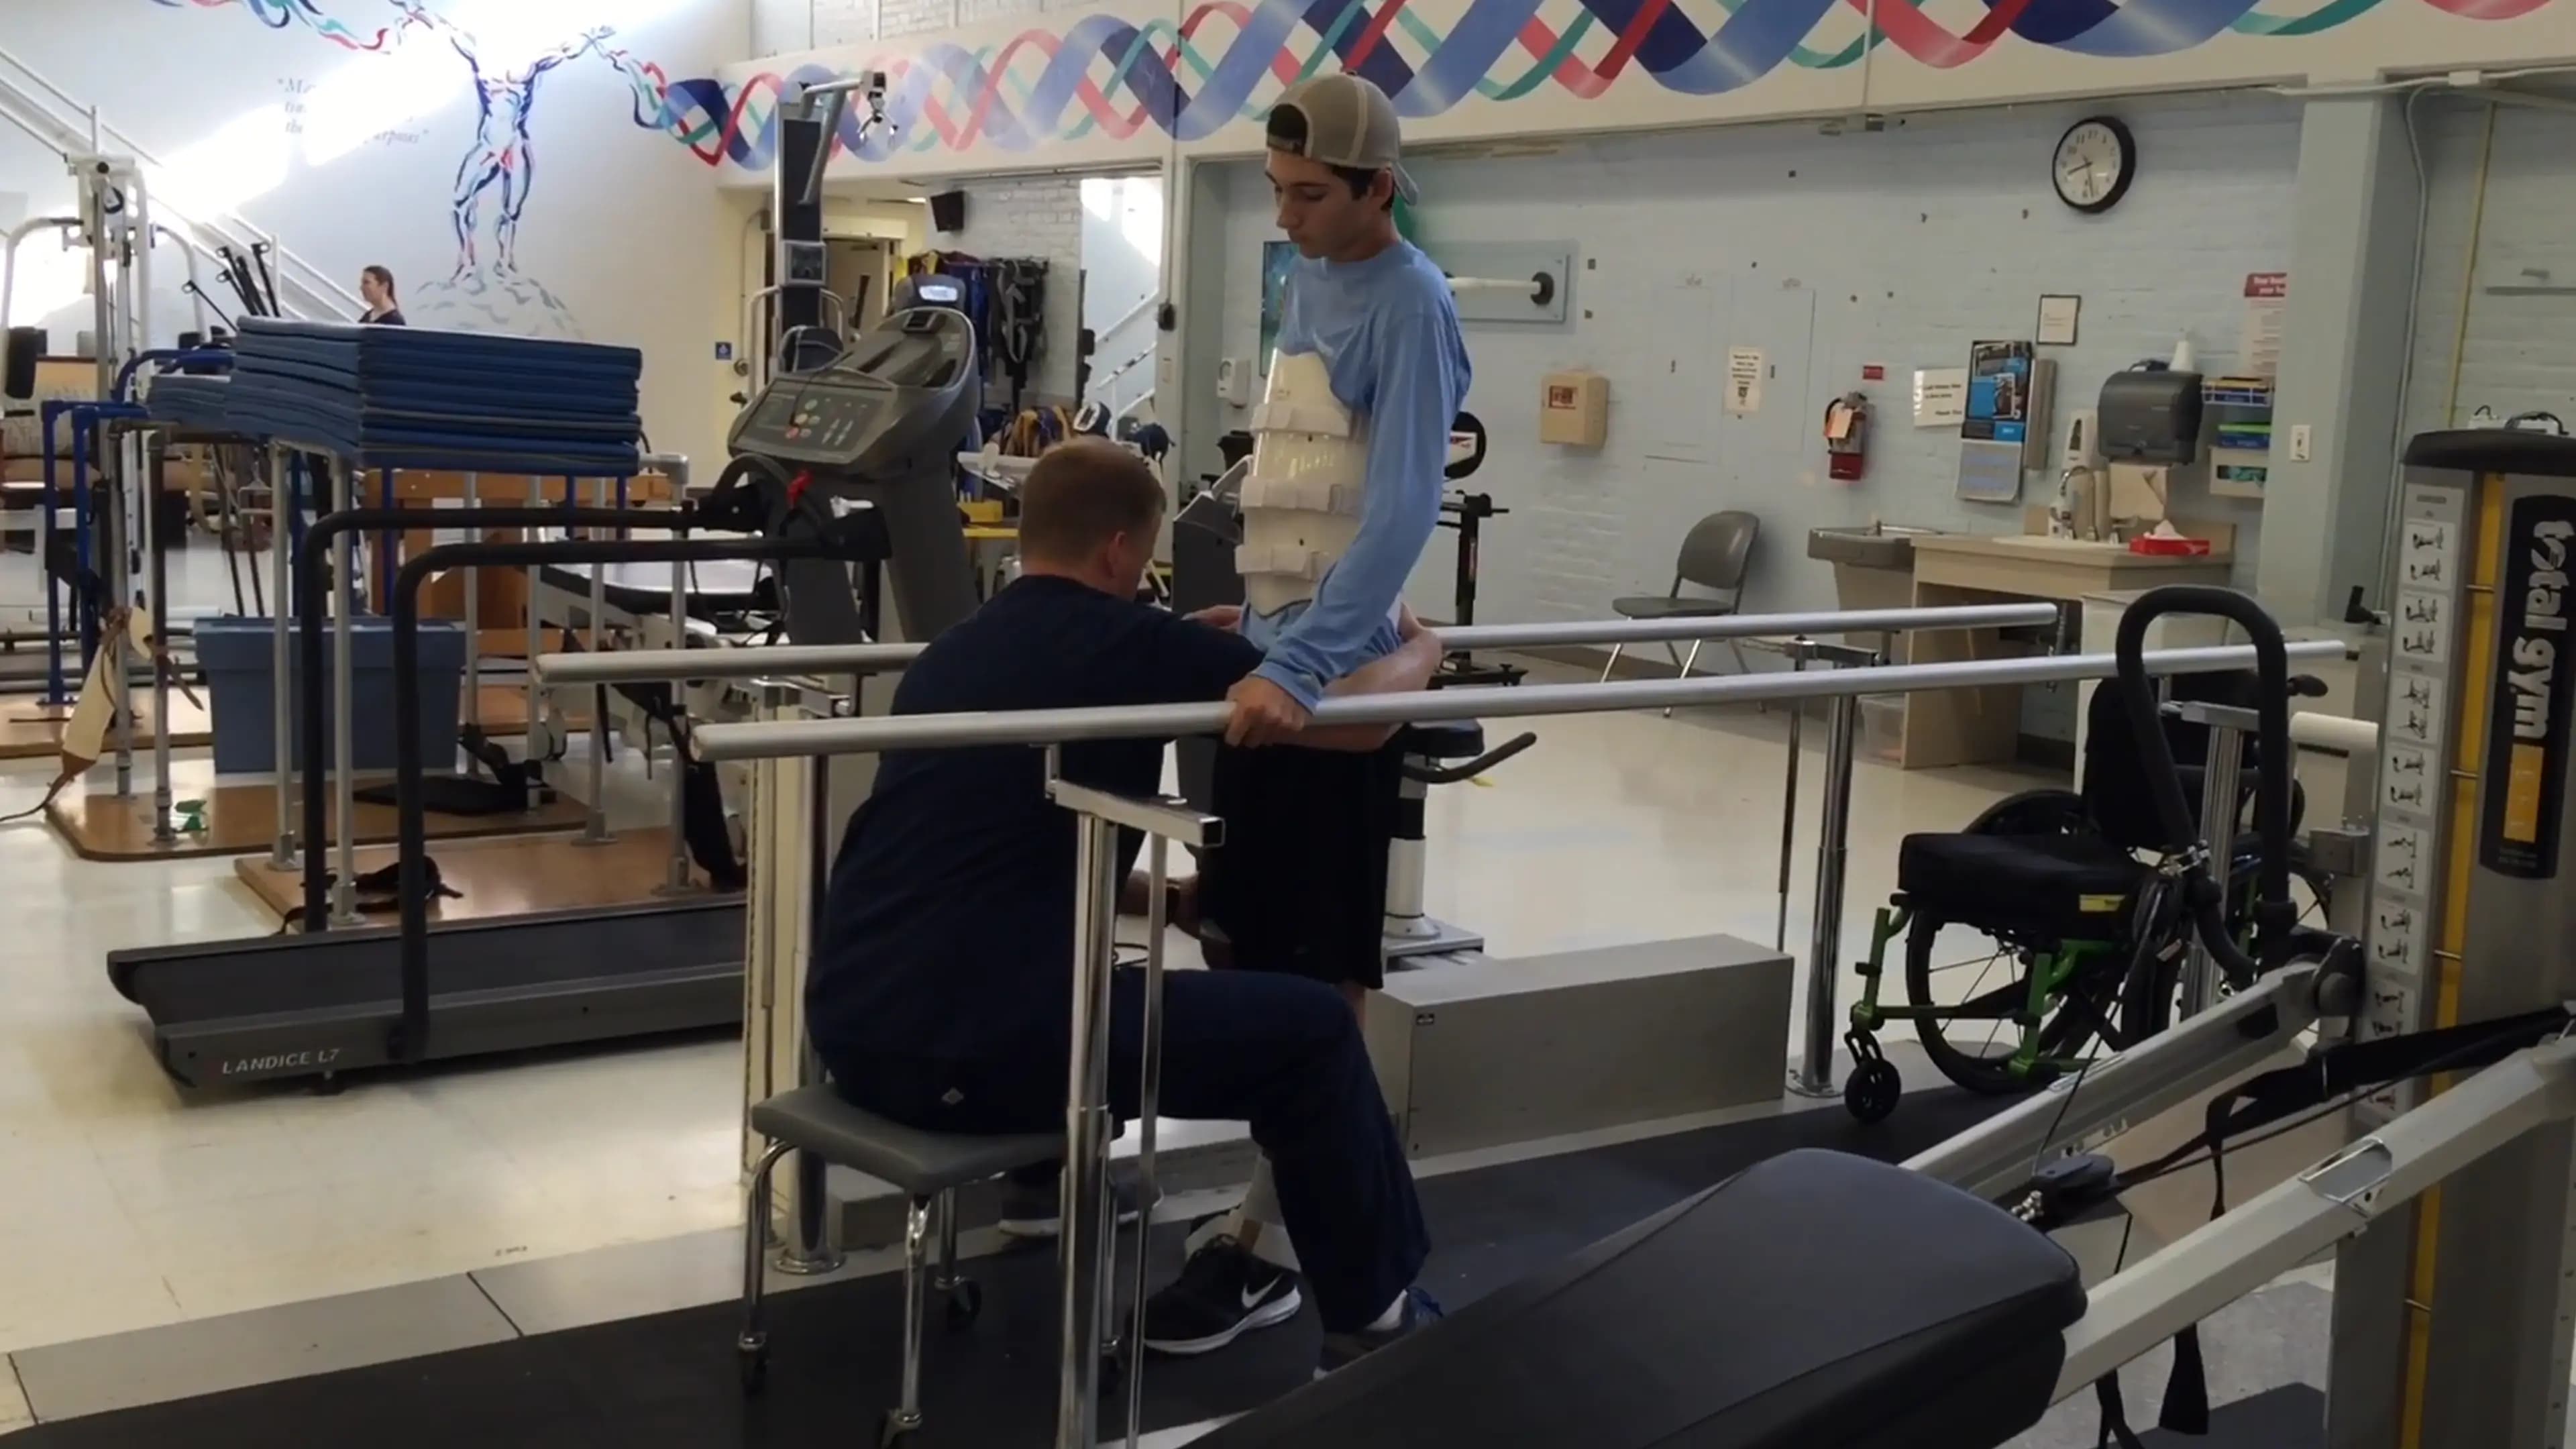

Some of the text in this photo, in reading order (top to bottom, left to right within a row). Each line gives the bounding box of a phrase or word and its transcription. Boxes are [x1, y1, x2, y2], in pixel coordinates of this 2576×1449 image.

[2524, 520, 2575, 631] total
[2508, 636, 2556, 739] gym
[222, 1048, 340, 1075] LANDICE L7
